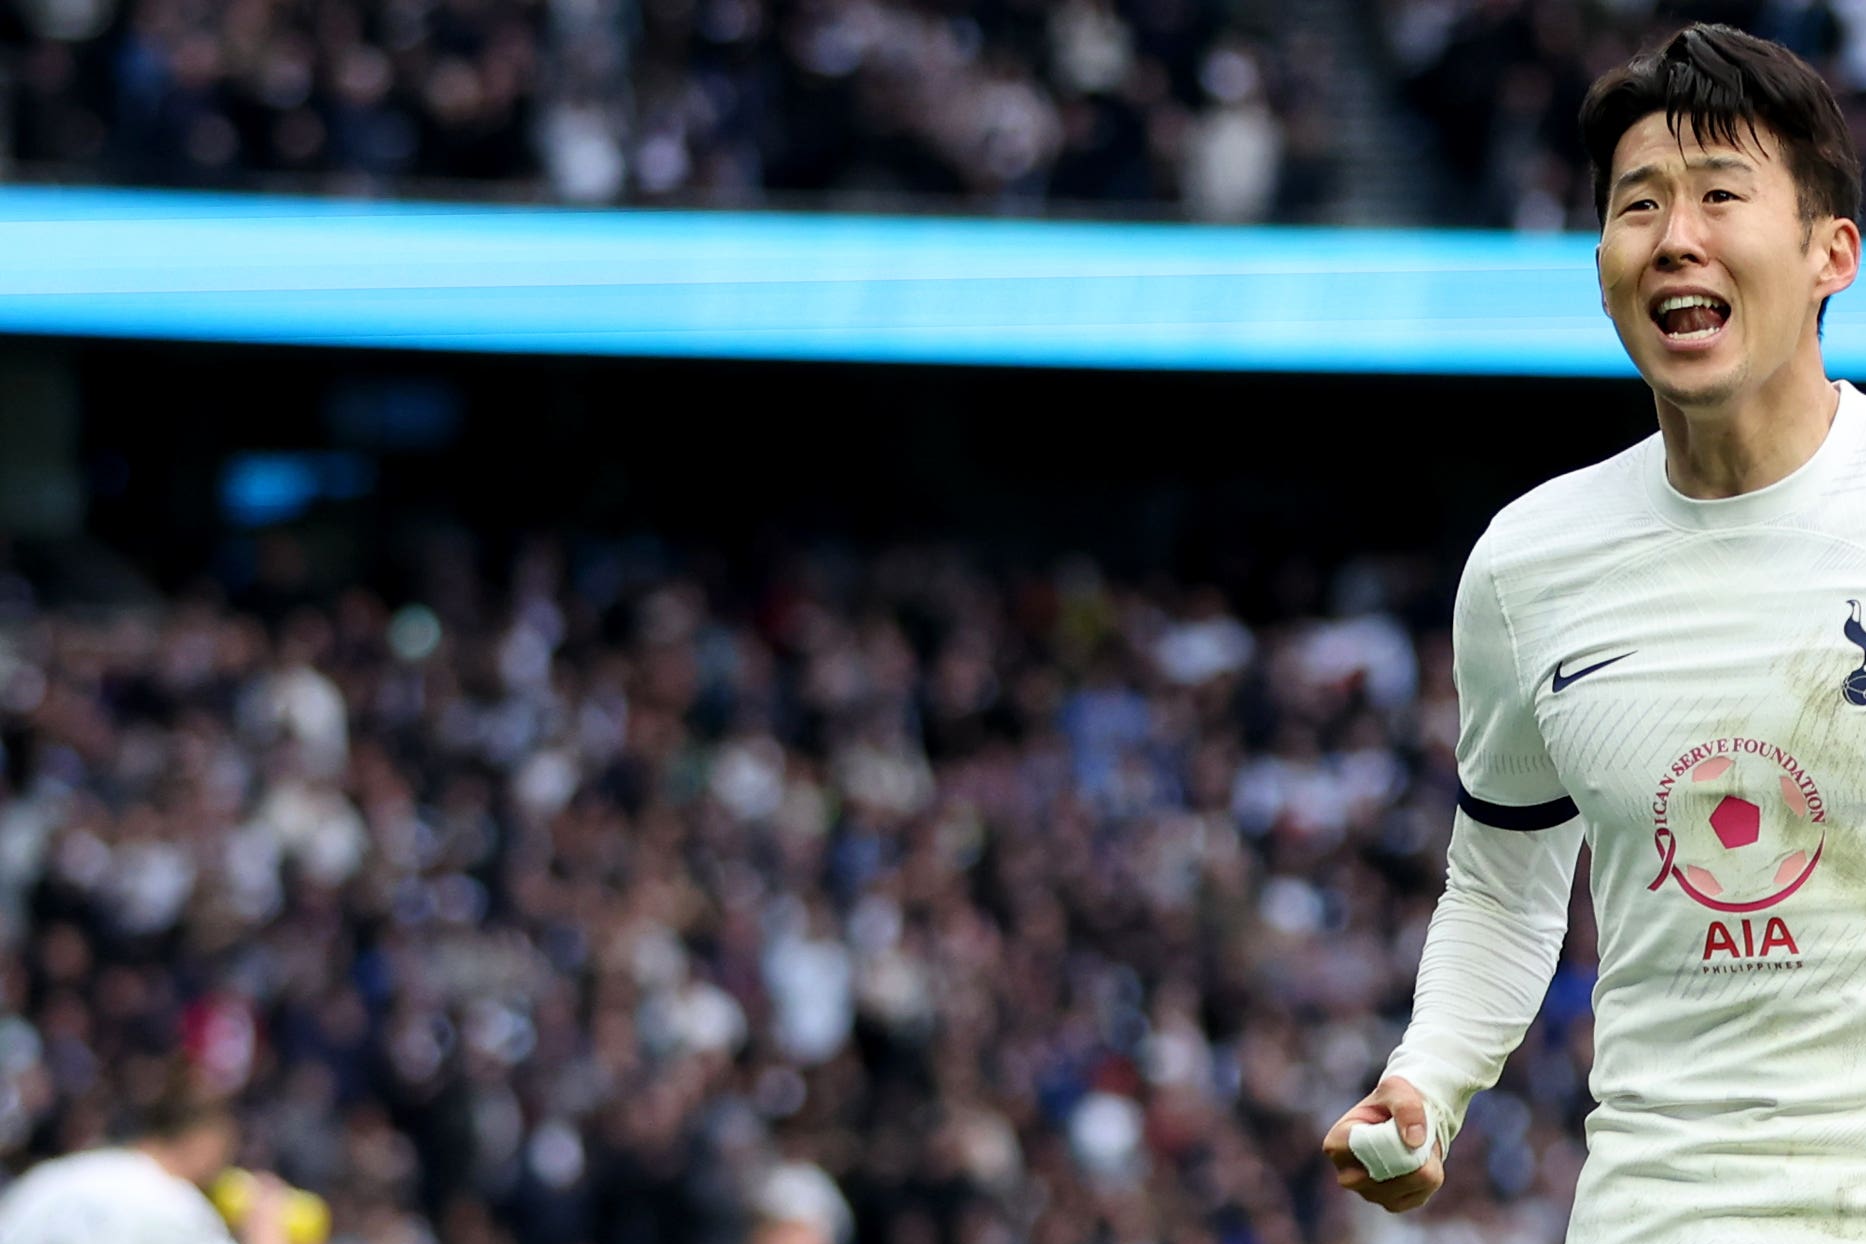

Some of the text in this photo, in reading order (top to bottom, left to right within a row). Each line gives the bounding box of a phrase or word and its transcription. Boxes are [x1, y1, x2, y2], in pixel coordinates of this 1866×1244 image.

[1671, 738, 1729, 777] SERVE
[1732, 737, 1826, 824] FOUNDATION
[1702, 916, 1800, 961] AIA
[1703, 960, 1804, 975] PHILIPPINES
